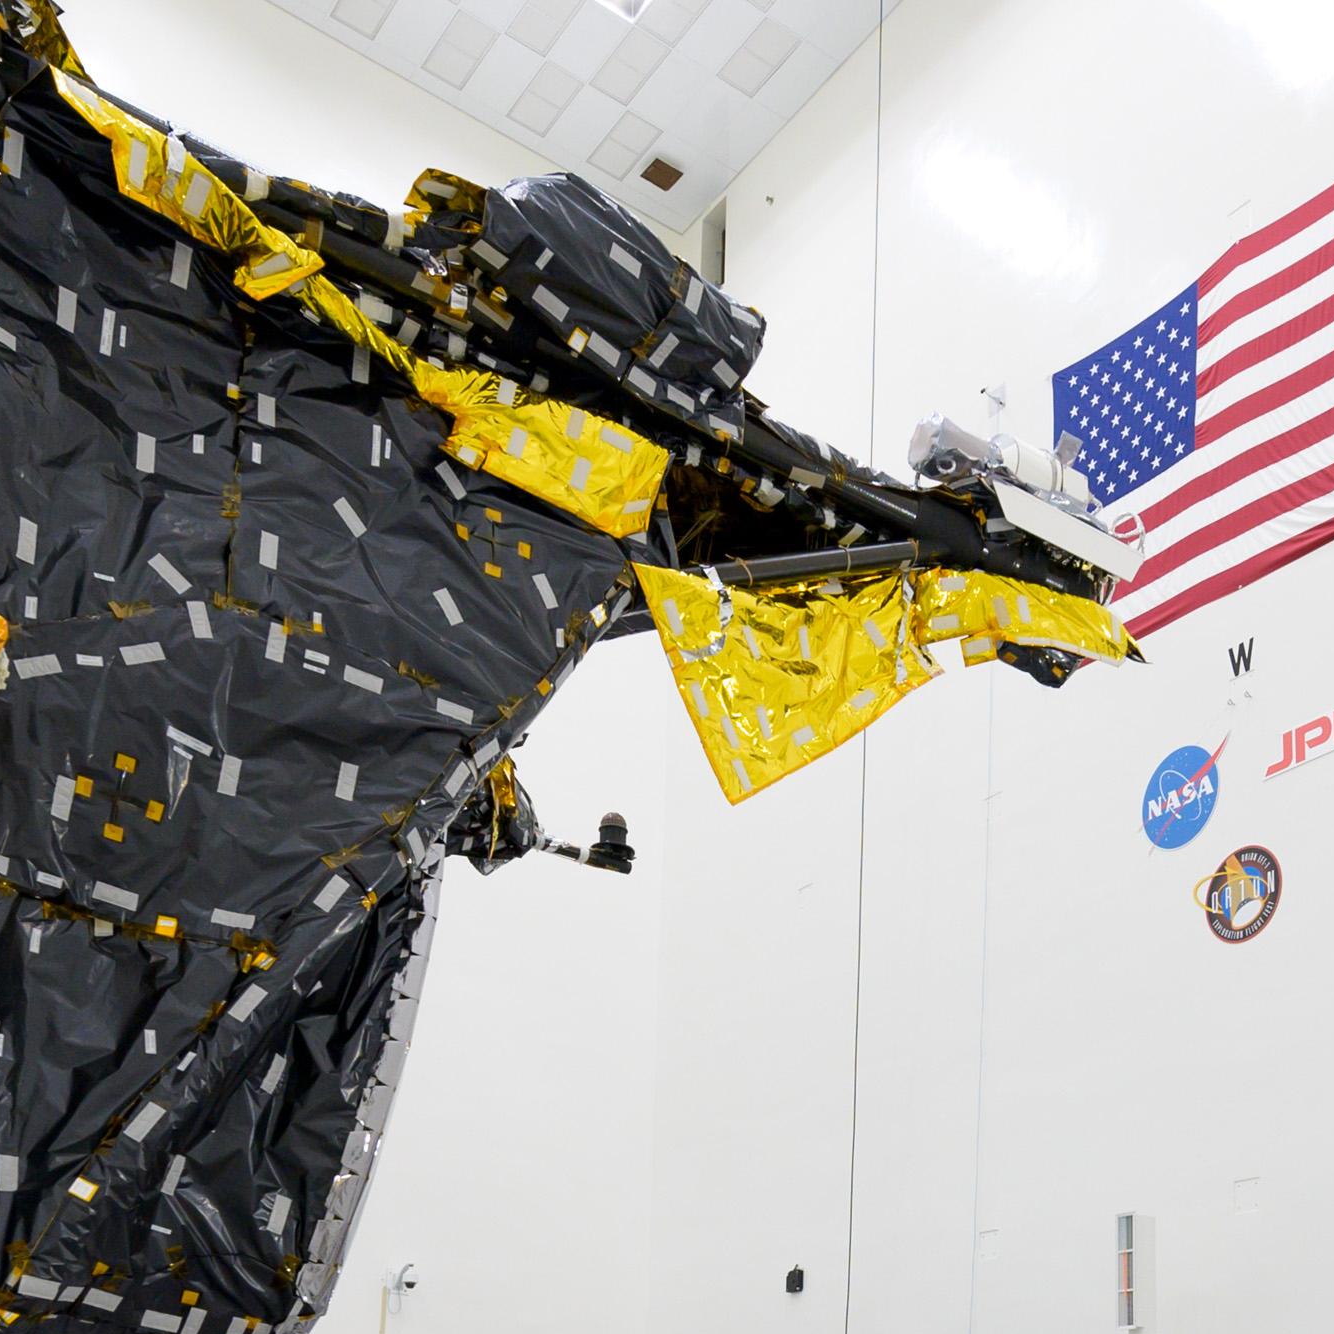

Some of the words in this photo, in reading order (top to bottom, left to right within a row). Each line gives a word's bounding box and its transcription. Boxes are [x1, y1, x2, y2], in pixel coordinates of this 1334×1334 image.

[1229, 637, 1254, 677] W
[1148, 775, 1215, 820] NASA
[1212, 914, 1244, 940] EXPLORATION
[1246, 917, 1264, 936] FLIGHT
